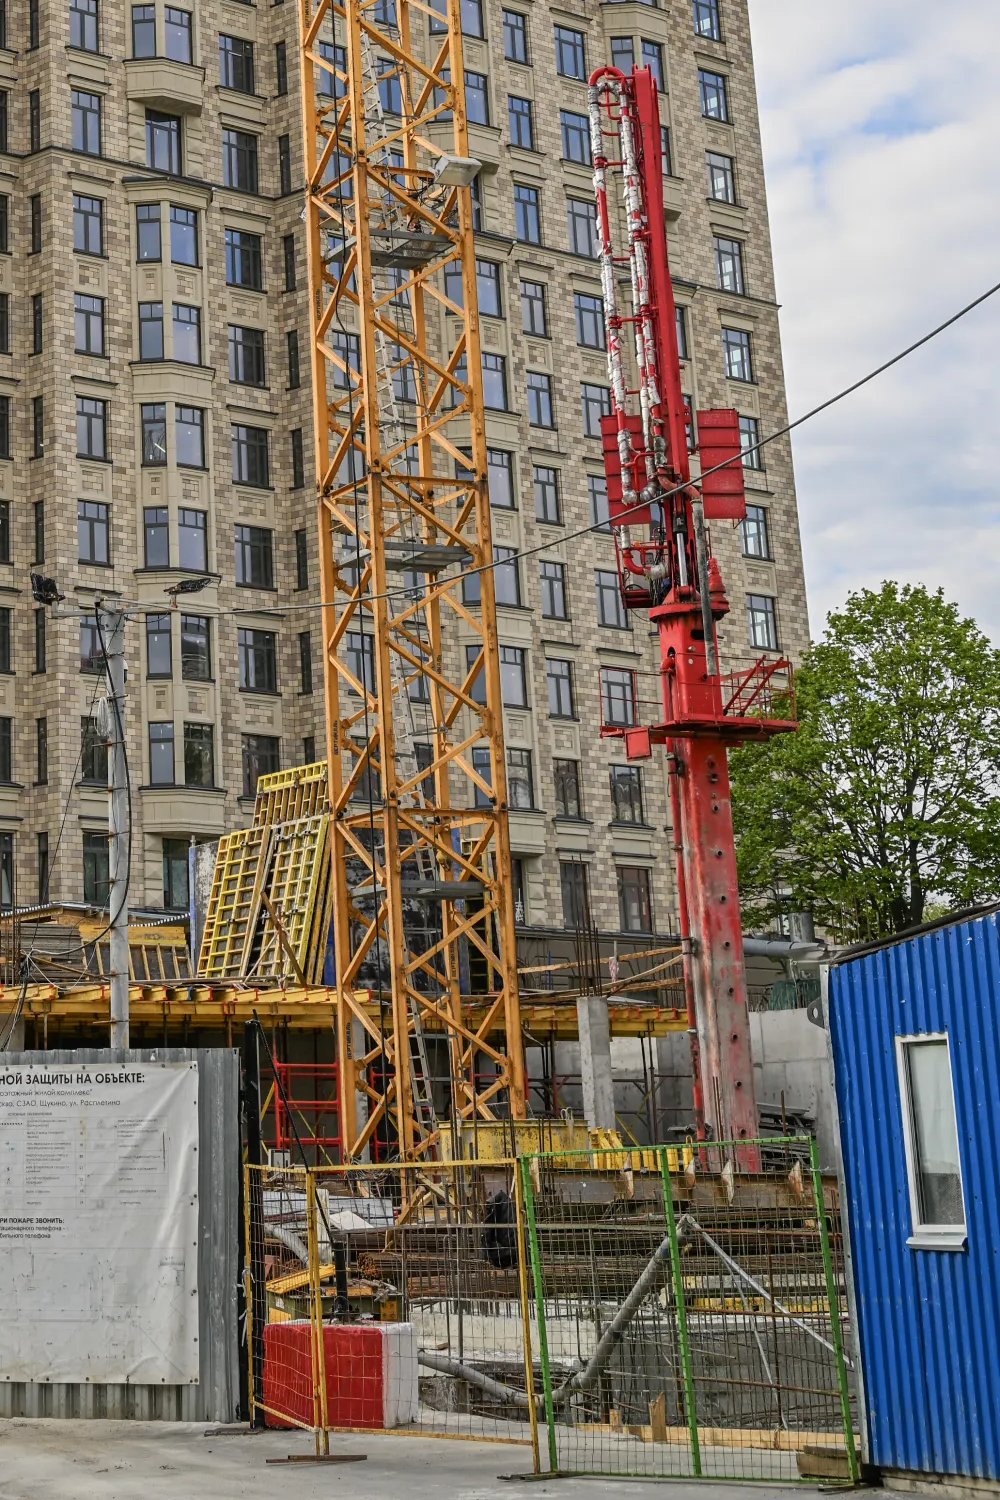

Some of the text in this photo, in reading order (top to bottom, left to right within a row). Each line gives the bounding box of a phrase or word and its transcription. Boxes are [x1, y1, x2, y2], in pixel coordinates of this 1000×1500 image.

[26, 1073, 73, 1086] ЗАЩИТЫ
[76, 1073, 92, 1084] НА
[95, 1072, 145, 1084] ОБЪЕКТЕ:
[34, 1089, 56, 1097] жилой
[80, 1098, 121, 1107] Расплетина
